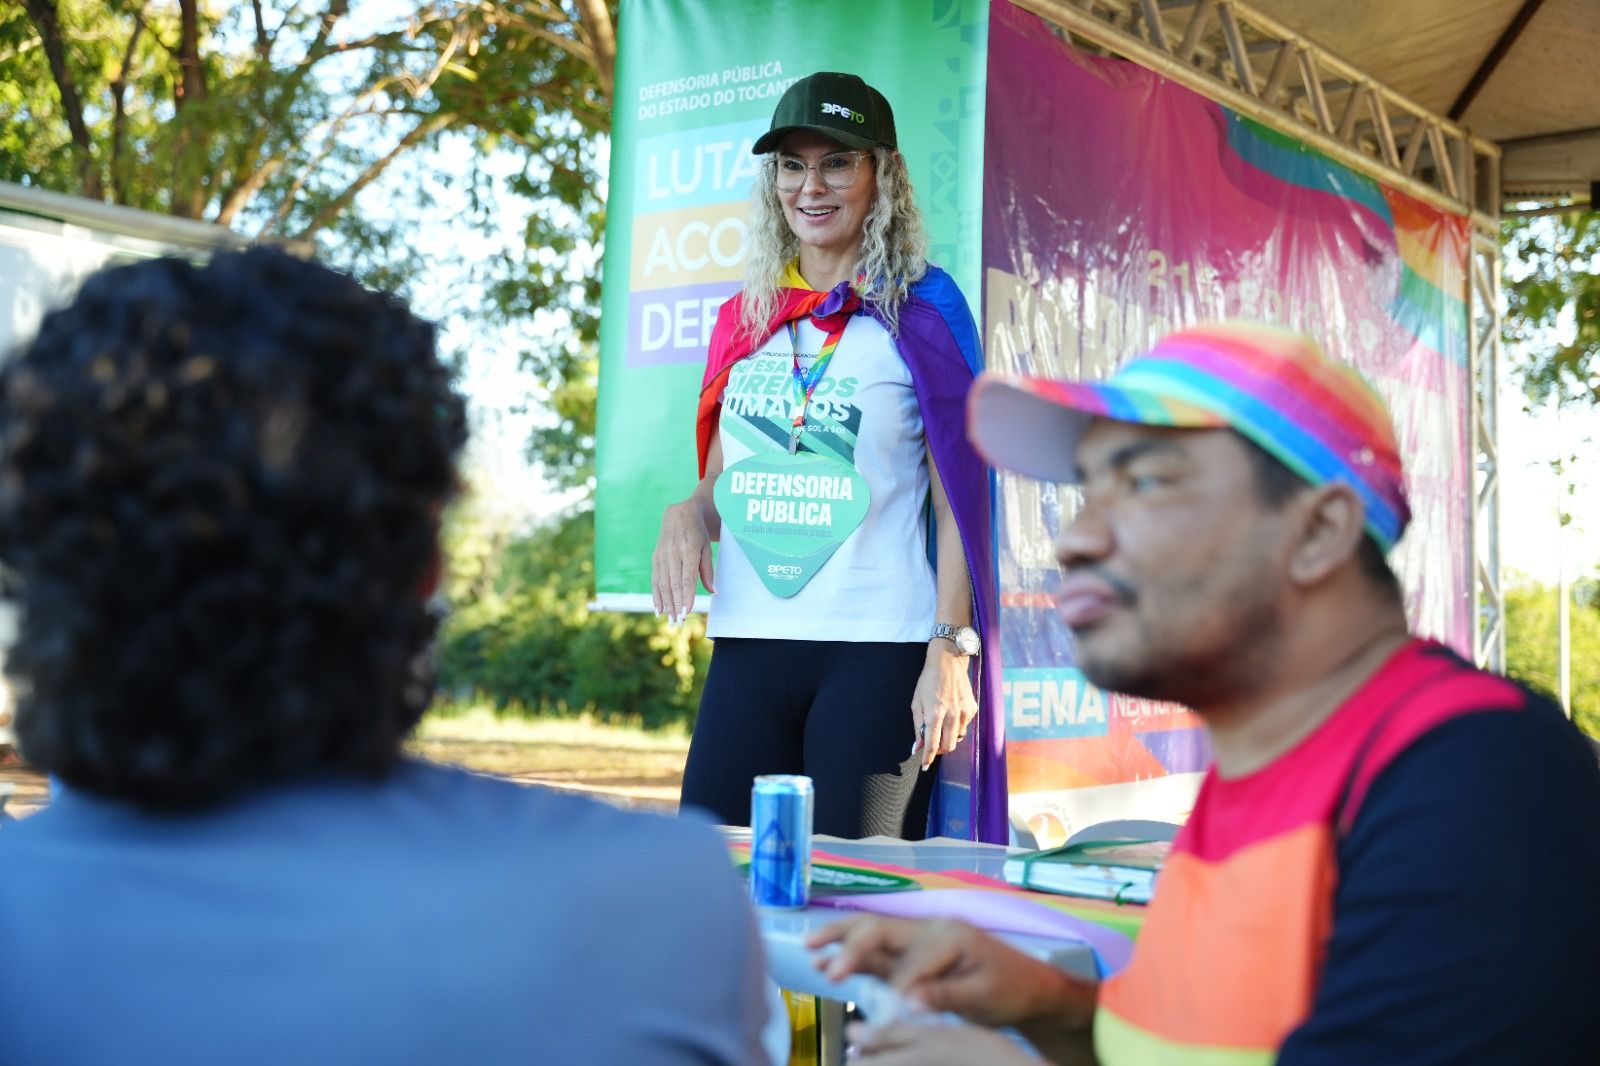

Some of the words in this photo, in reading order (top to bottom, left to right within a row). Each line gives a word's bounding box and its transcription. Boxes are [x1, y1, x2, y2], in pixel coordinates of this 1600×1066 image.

[639, 74, 720, 102] DEFENSORIA
[722, 59, 783, 85] PÚBLICA
[638, 104, 657, 121] DO
[659, 92, 710, 116] ESTADO
[713, 88, 735, 106] DO
[725, 374, 859, 398] DIREIOS
[730, 471, 853, 501] DEFENSORIA
[747, 496, 832, 526] PÚBLICA
